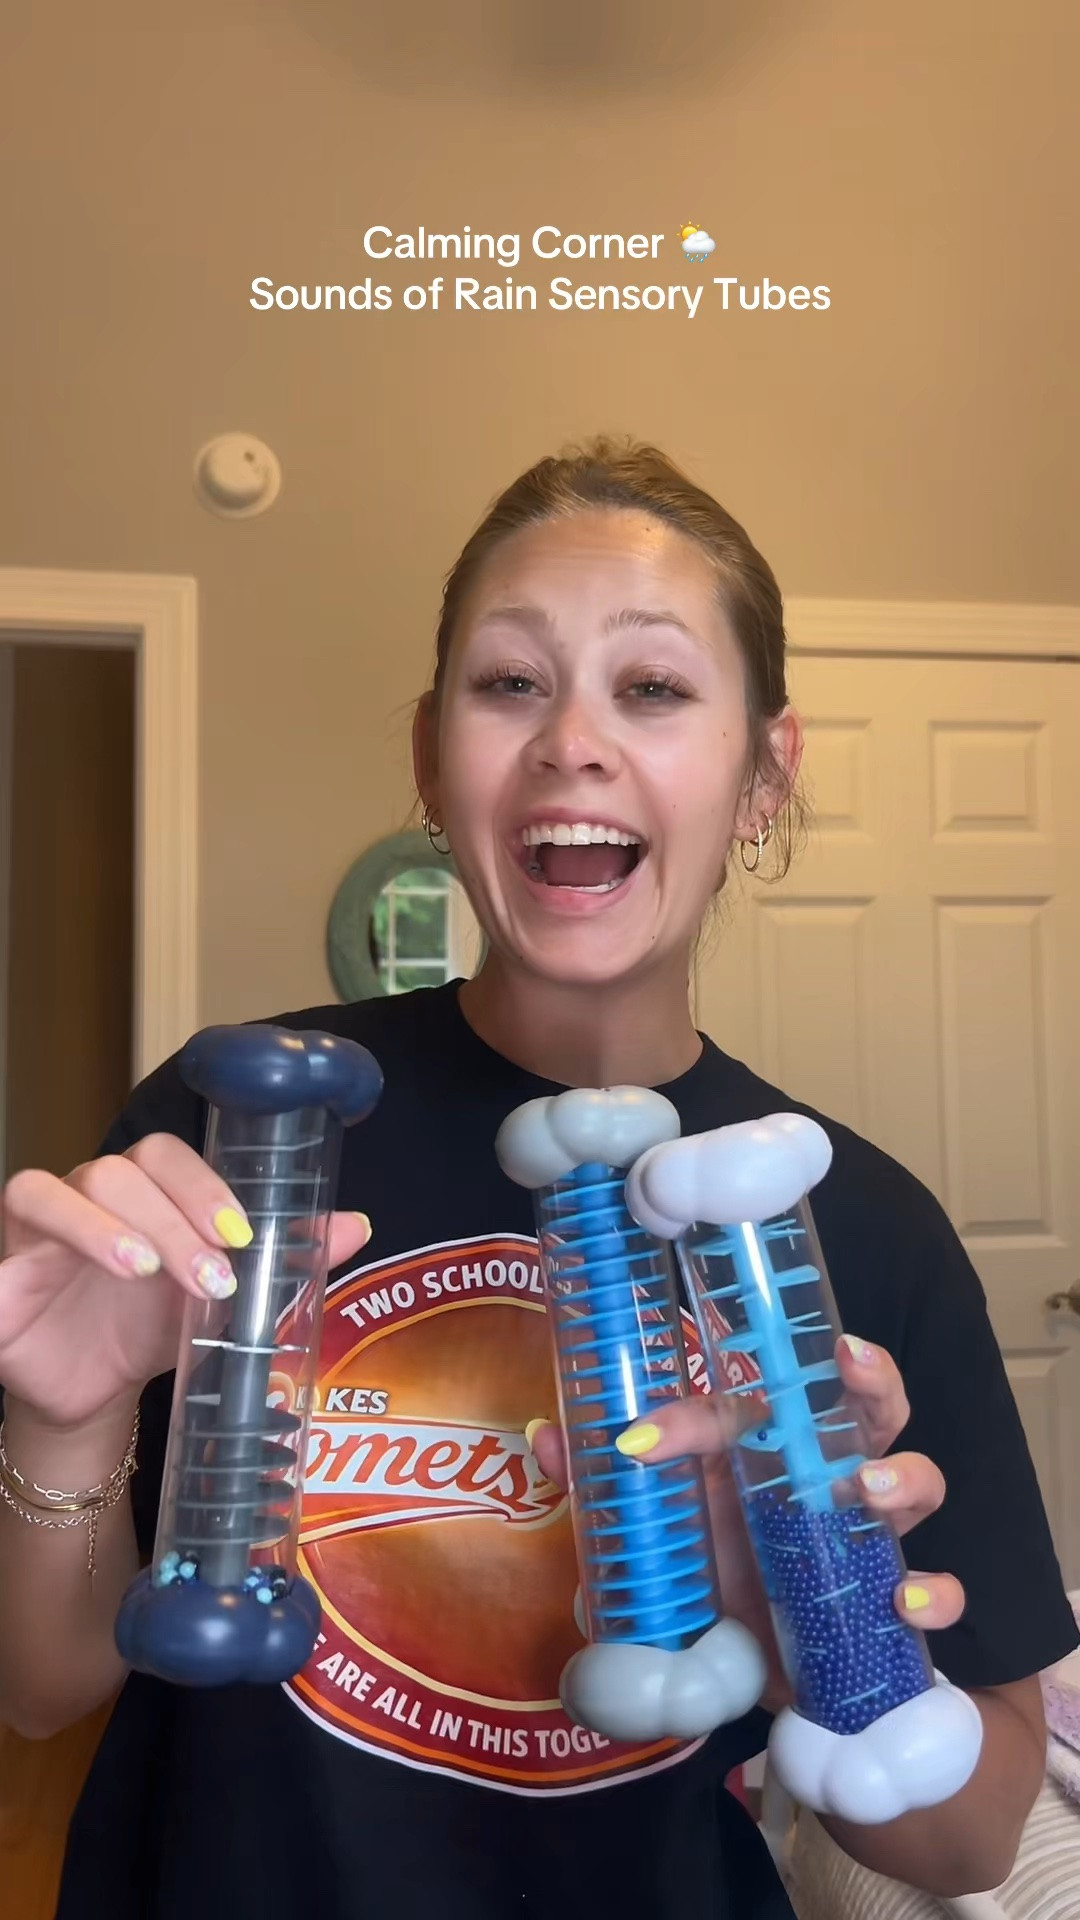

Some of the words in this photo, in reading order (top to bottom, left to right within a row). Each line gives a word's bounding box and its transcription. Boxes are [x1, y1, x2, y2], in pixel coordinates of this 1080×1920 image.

[340, 1281, 415, 1328] TWO
[304, 1429, 541, 1513] omets
[316, 1651, 378, 1702] ARE
[372, 1687, 422, 1729] ALL
[429, 1709, 463, 1741] IN
[468, 1719, 528, 1758] THIS
[534, 1724, 611, 1758] TOGE
